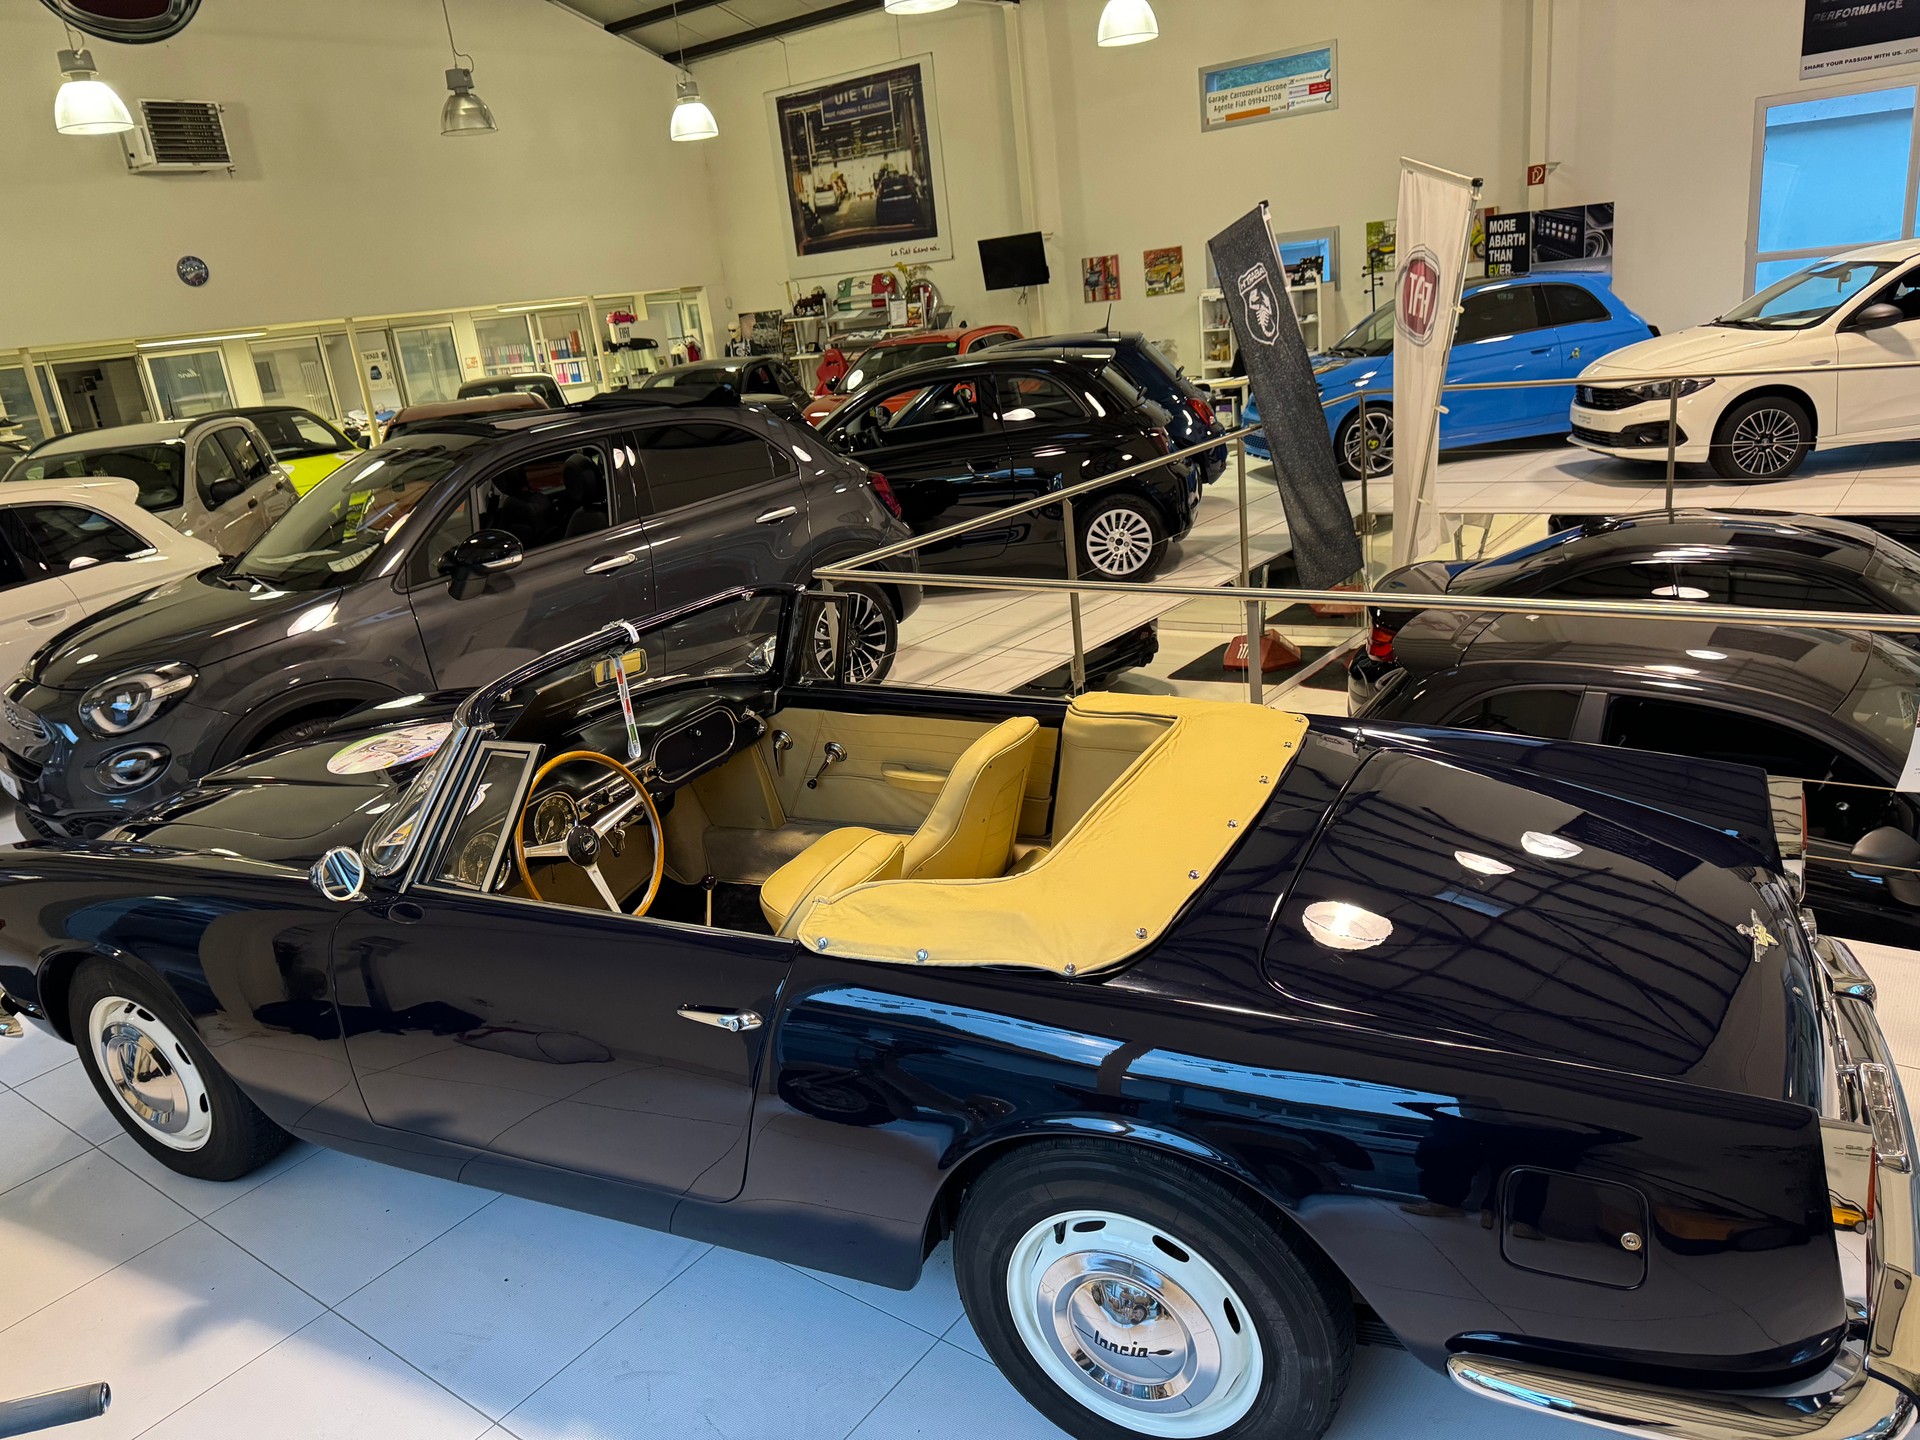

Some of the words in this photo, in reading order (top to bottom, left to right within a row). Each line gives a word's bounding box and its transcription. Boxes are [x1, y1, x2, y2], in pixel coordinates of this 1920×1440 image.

[1812, 0, 1904, 21] PERFORMANCE
[1804, 63, 1824, 71] SHARE
[1844, 55, 1872, 64] PASSION
[862, 84, 874, 99] 17
[1207, 94, 1228, 104] Garage
[1229, 87, 1262, 100] Carrozzeria
[1263, 82, 1287, 93] Ciccone
[1213, 102, 1234, 113] Agente
[1235, 98, 1247, 108] Fiat
[1247, 92, 1282, 106] 0919427108
[1489, 218, 1517, 234] MORE
[1488, 232, 1526, 249] ABARTH
[1488, 248, 1513, 263] THAN
[1488, 262, 1515, 276] EVER.
